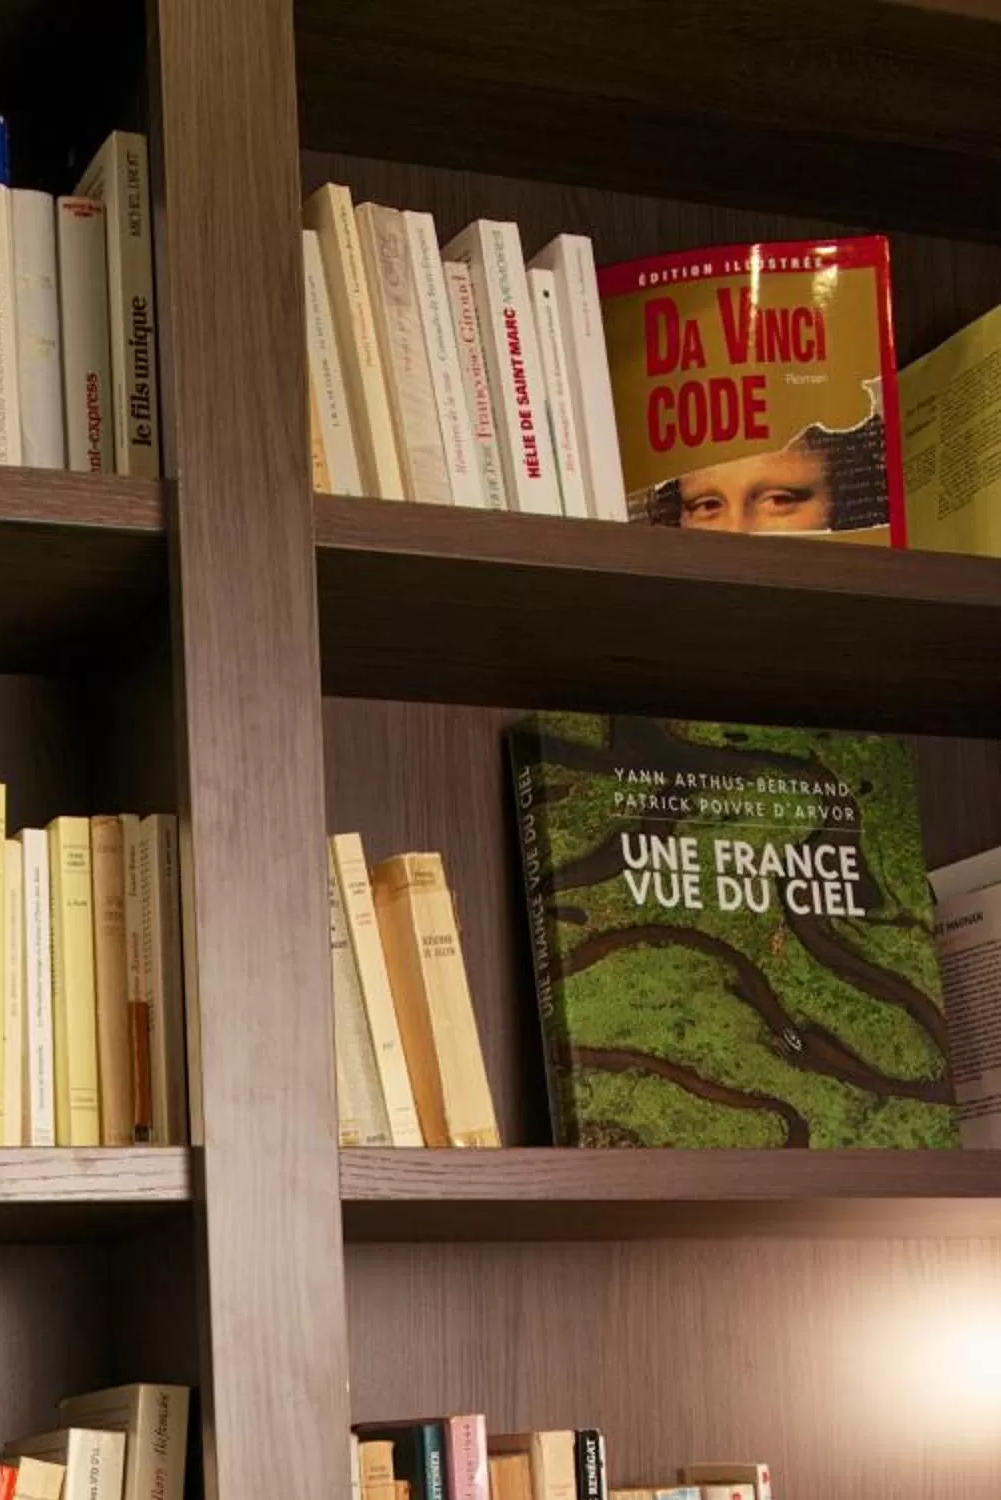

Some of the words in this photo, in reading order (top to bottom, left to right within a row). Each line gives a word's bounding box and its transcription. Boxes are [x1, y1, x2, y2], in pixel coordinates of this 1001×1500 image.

[638, 262, 713, 287] ÉDITION
[128, 295, 153, 379] unique
[503, 306, 522, 357] MARC
[129, 383, 151, 419] fils
[510, 359, 530, 406] SAINT
[86, 371, 101, 473] nt-express
[131, 423, 151, 447] le
[519, 410, 536, 431] DE
[646, 375, 770, 454] CODE
[521, 434, 541, 480] HÉLIE
[518, 765, 532, 809] CIEL
[613, 767, 666, 786] YANN
[674, 772, 849, 798] ARTHUS-BERTRAND
[523, 813, 536, 844] DU
[613, 791, 691, 812] PATRICK
[699, 797, 766, 818] POIVRE
[773, 800, 856, 822] D'ARVOR
[526, 847, 541, 890] VUE
[620, 832, 700, 870] UNE
[713, 840, 861, 881] FRANCE
[622, 869, 704, 908] VUE
[716, 877, 770, 914] DU
[785, 880, 867, 918] CIEL
[534, 893, 551, 971] FRANCE
[540, 975, 554, 1018] UNE
[585, 1436, 599, 1495] RENÉGAT
